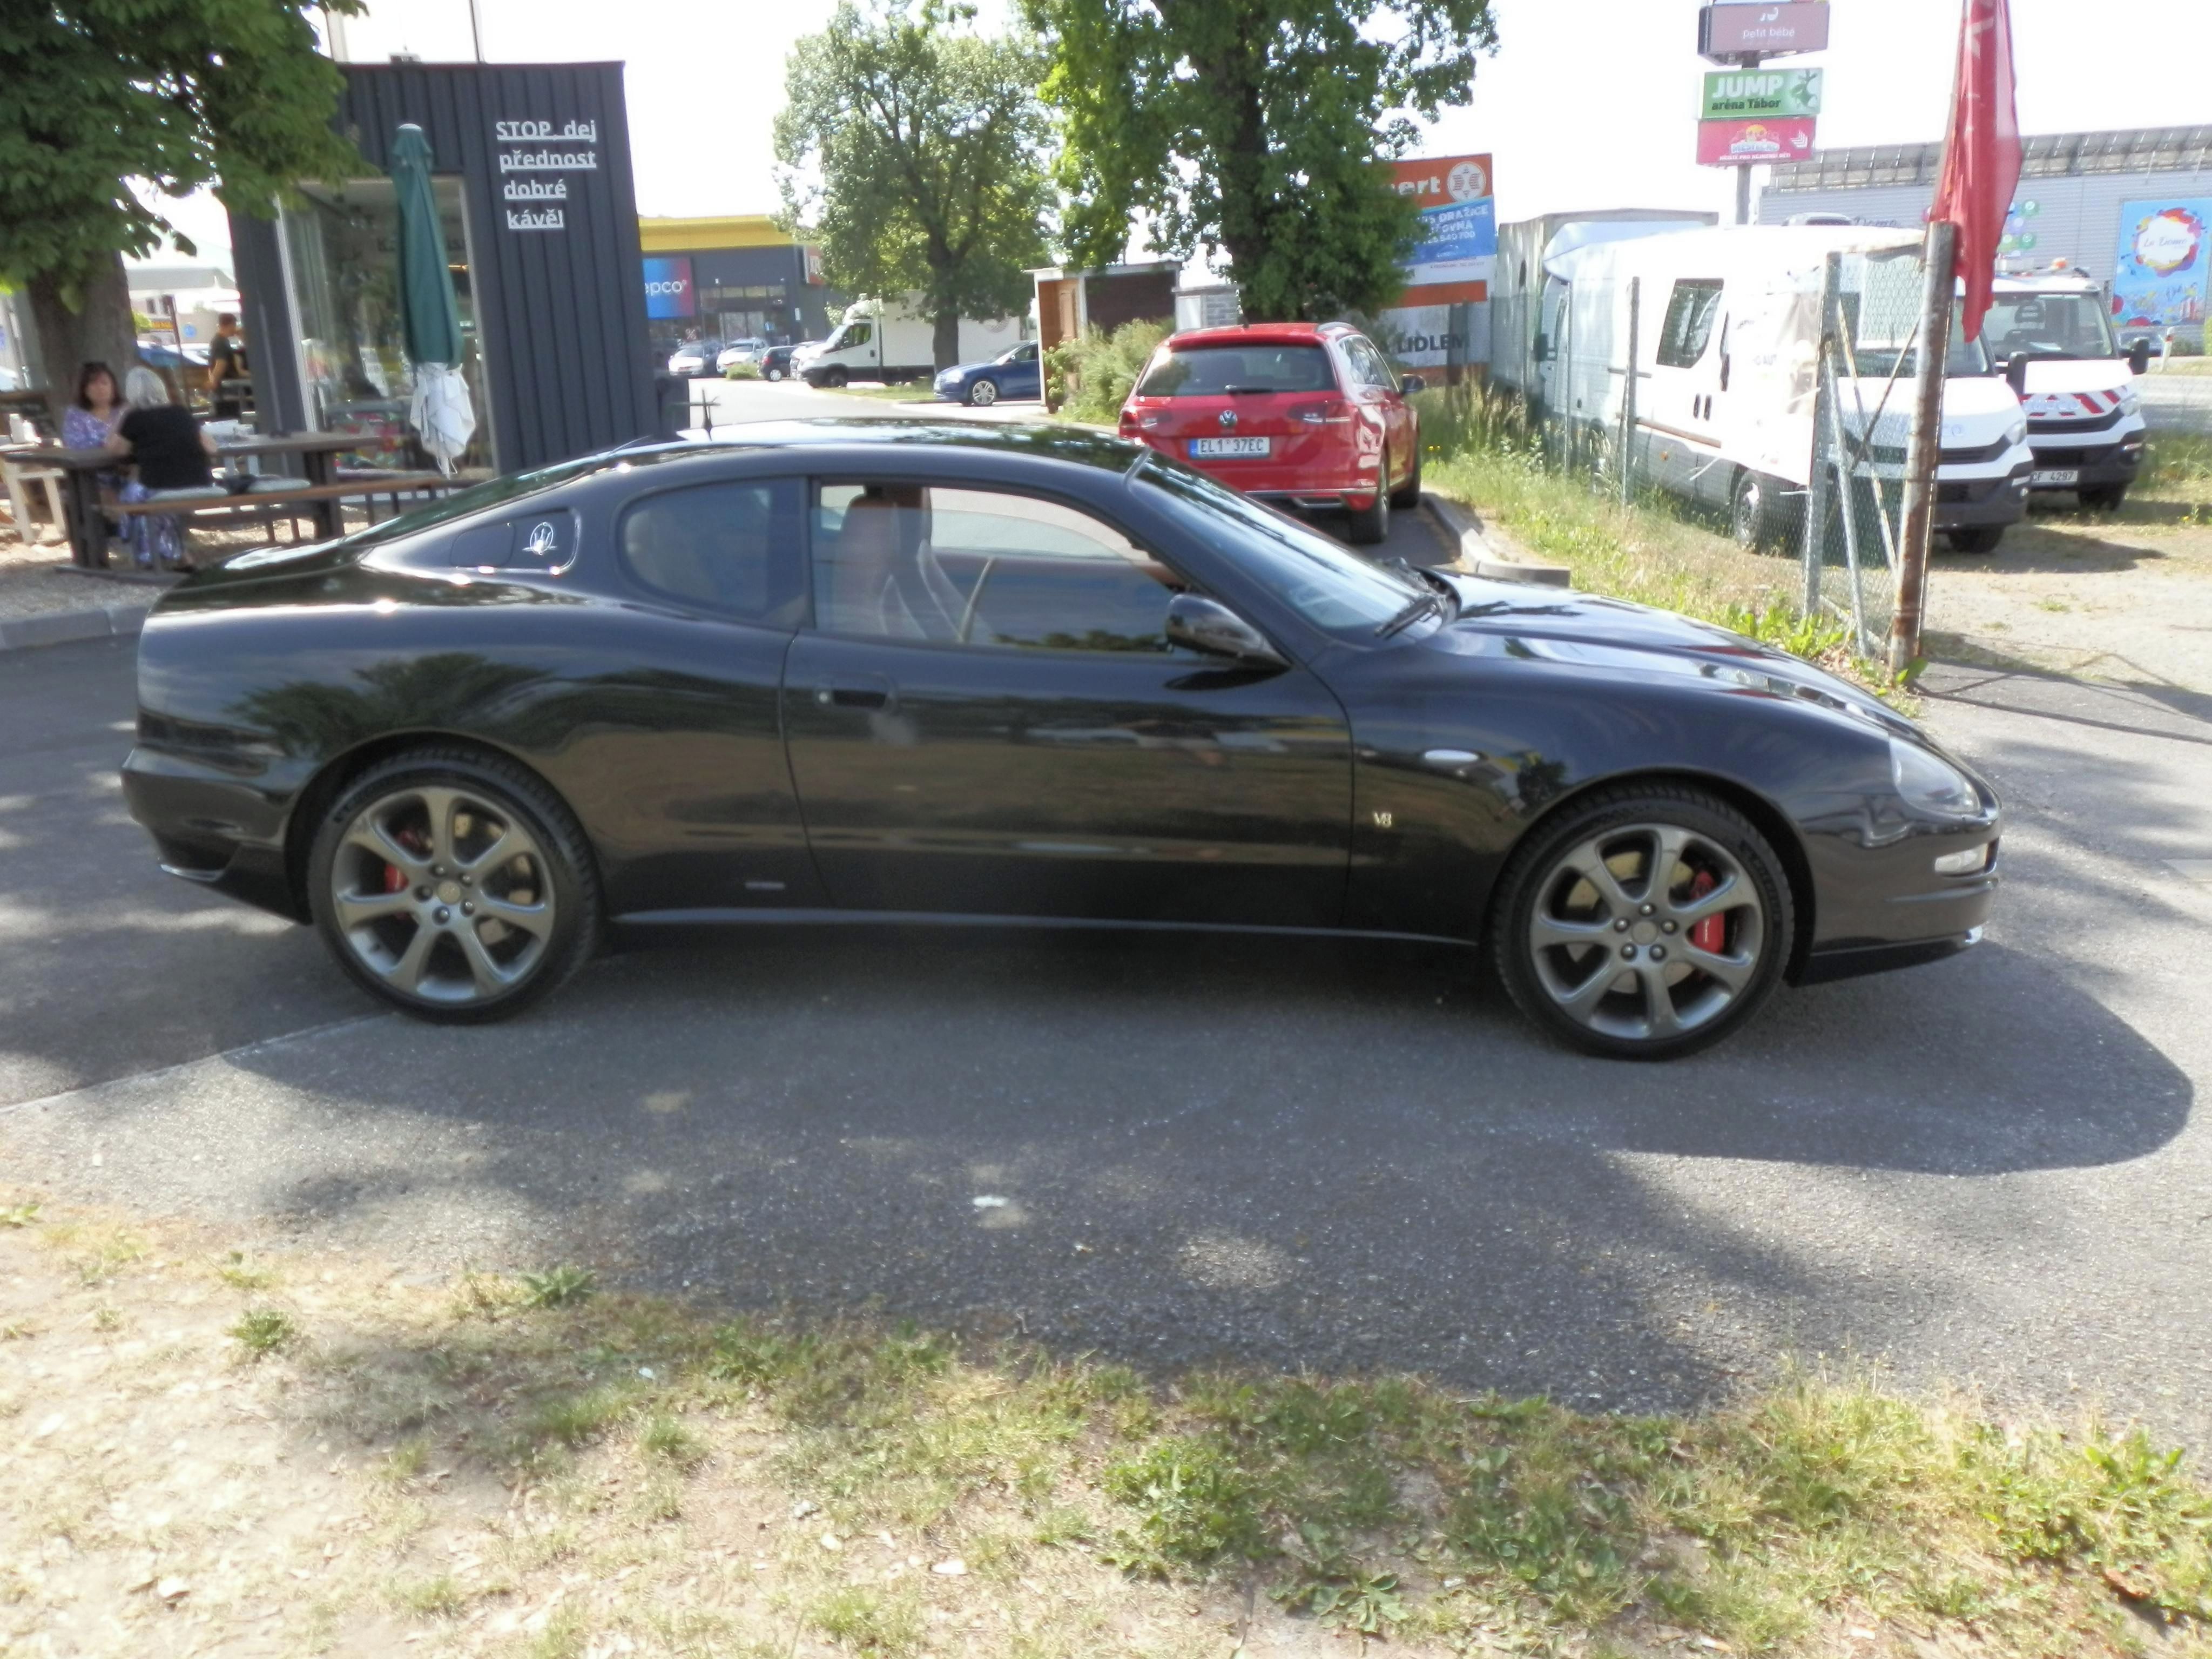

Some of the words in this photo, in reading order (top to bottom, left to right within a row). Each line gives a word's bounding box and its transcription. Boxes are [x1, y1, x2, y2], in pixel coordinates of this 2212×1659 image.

[1712, 75, 1783, 98] JUMP
[1711, 98, 1745, 110] aréna
[1747, 98, 1781, 109] Tábor
[564, 119, 596, 143] dej
[499, 149, 596, 173] přednost
[503, 179, 567, 199] dobré
